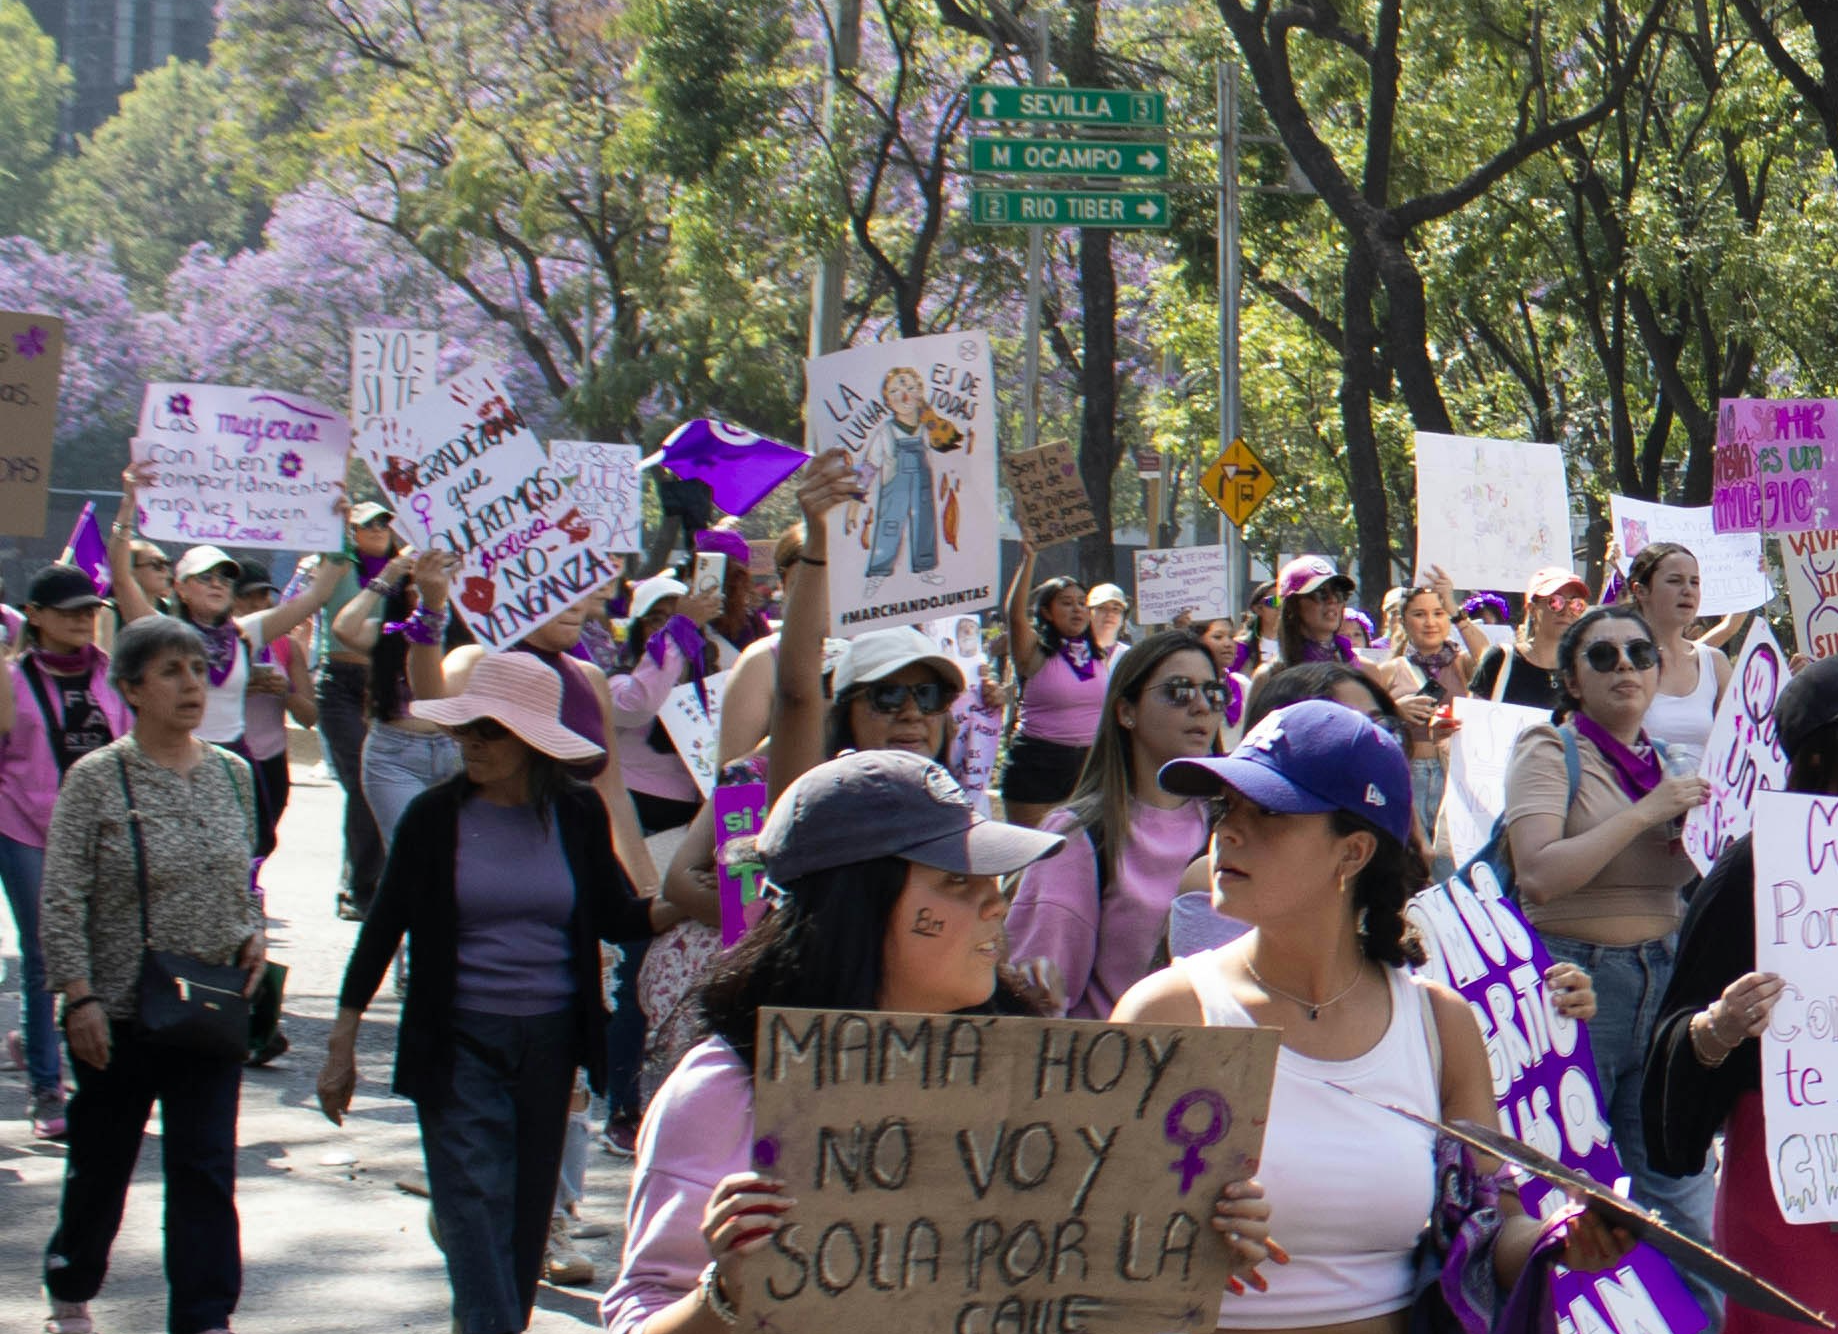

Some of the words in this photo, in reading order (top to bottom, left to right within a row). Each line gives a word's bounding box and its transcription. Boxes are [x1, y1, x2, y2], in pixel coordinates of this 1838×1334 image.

[1020, 94, 1112, 118] SEVILLA
[1136, 98, 1150, 117] 3
[991, 145, 1011, 167] M
[1023, 147, 1122, 170] OCAMPO
[989, 201, 1001, 215] 2
[1020, 197, 1058, 218] RIO
[1066, 197, 1125, 220] TIBER
[372, 332, 409, 374] YO
[360, 374, 384, 415] SI
[930, 363, 957, 387] ES
[960, 370, 982, 398] DE
[152, 404, 199, 435] Las
[824, 381, 864, 423] LA
[927, 385, 979, 422] TODAS
[216, 411, 321, 453] mujeres
[836, 398, 889, 454] LUCHA
[428, 467, 562, 557] QUEREMOS
[446, 468, 492, 518] que
[501, 546, 548, 591] NO
[471, 547, 613, 647] VENGANZA
[840, 584, 991, 627] #MARCHANDOJUNTAS
[723, 806, 754, 833] si
[768, 1013, 998, 1091] MAMÁ
[1032, 1027, 1186, 1120] HOY
[1776, 1047, 1828, 1108] te
[814, 1115, 916, 1195] NO
[954, 1117, 1123, 1218] VOY
[766, 1216, 942, 1302] SOLA
[962, 1216, 1091, 1293] POR
[1116, 1209, 1202, 1284] LA
